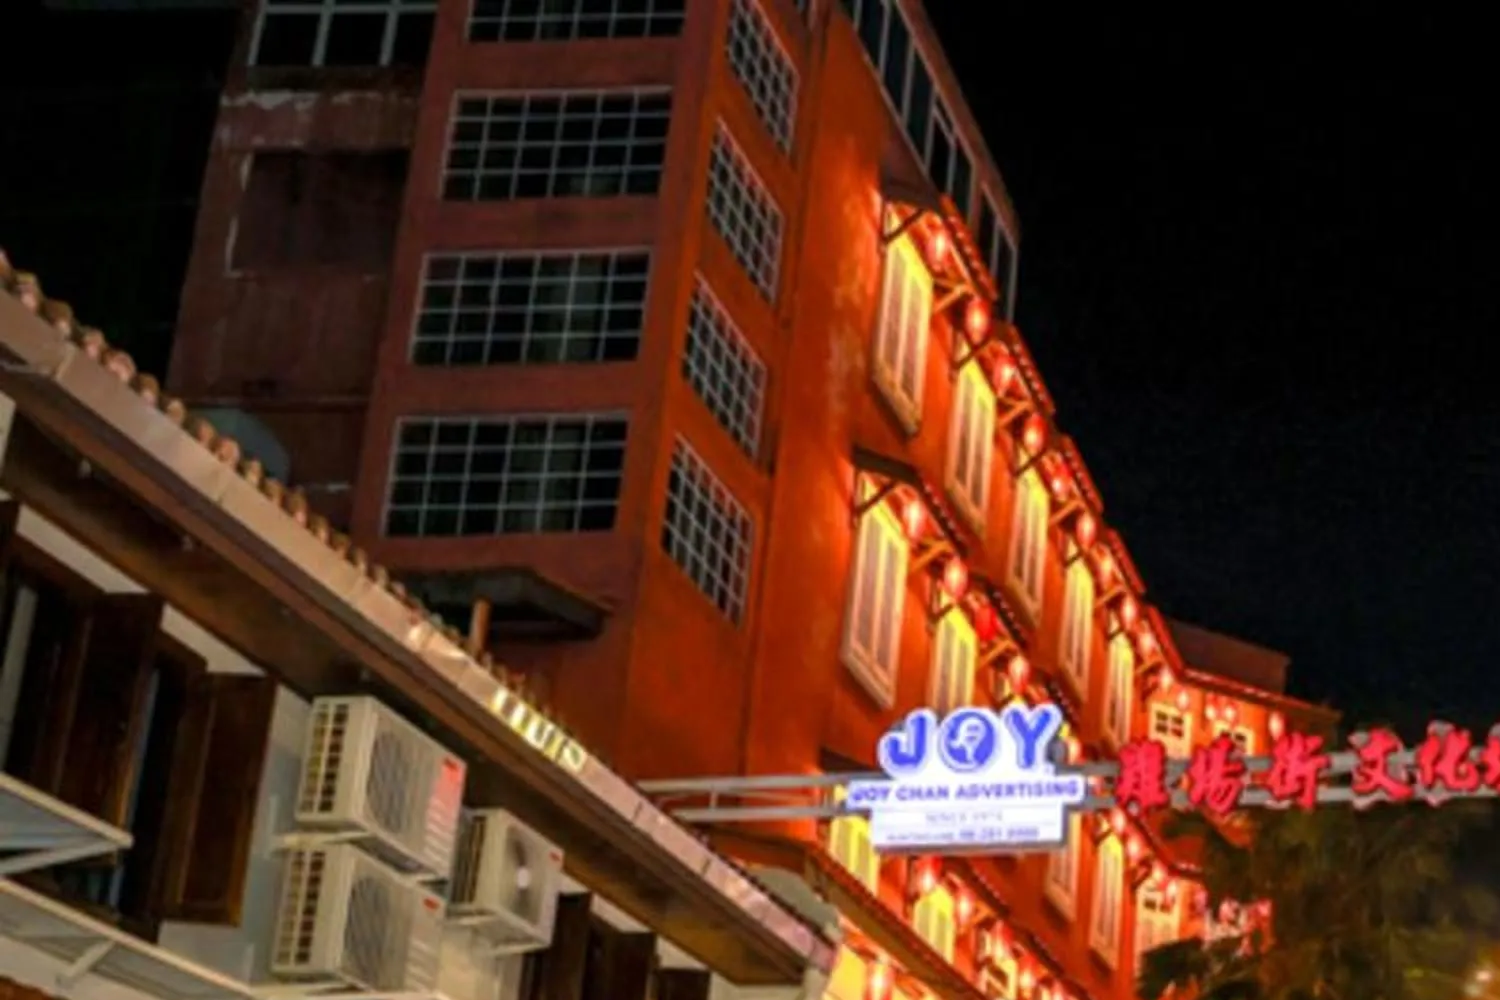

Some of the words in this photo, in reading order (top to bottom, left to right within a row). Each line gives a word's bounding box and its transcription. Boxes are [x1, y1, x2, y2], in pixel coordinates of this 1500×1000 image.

[886, 707, 1060, 773] JOY
[852, 785, 891, 801] JOY
[895, 785, 949, 801] CHAN
[954, 780, 1079, 799] ADVERTISING
